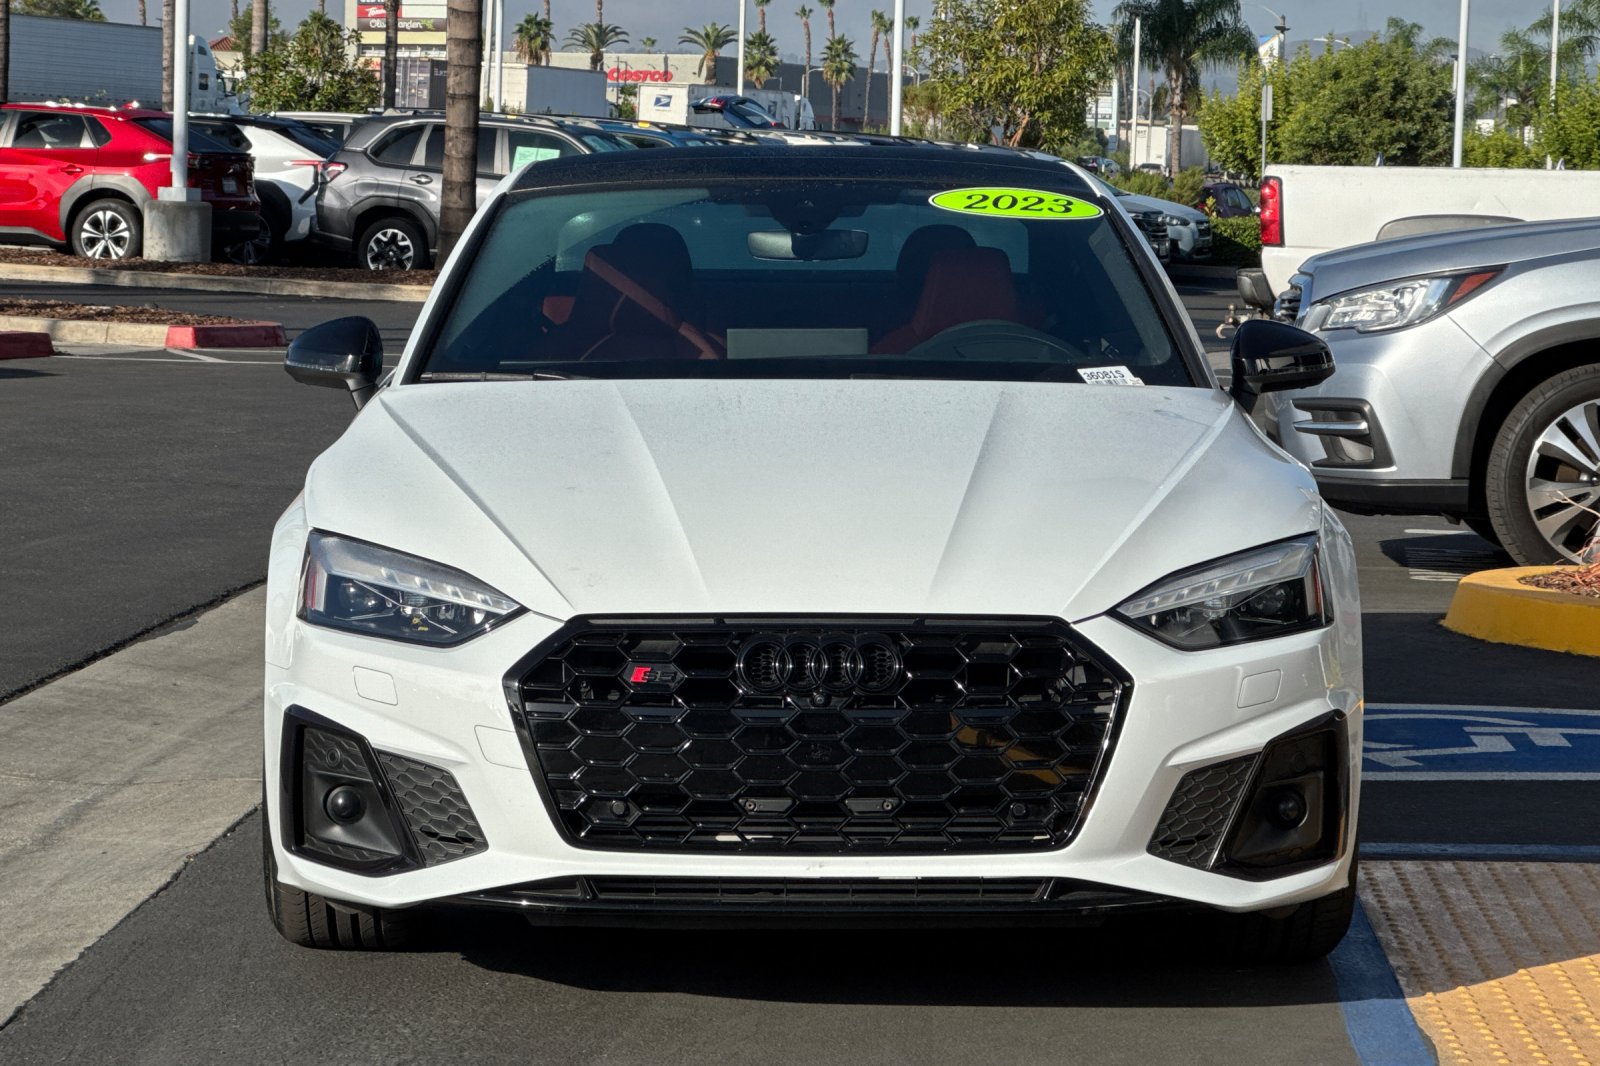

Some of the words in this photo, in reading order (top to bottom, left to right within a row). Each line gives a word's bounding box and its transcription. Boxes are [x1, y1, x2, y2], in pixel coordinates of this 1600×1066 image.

[397, 20, 422, 30] arden
[607, 67, 673, 82] COSTCO
[963, 193, 1074, 214] 2023
